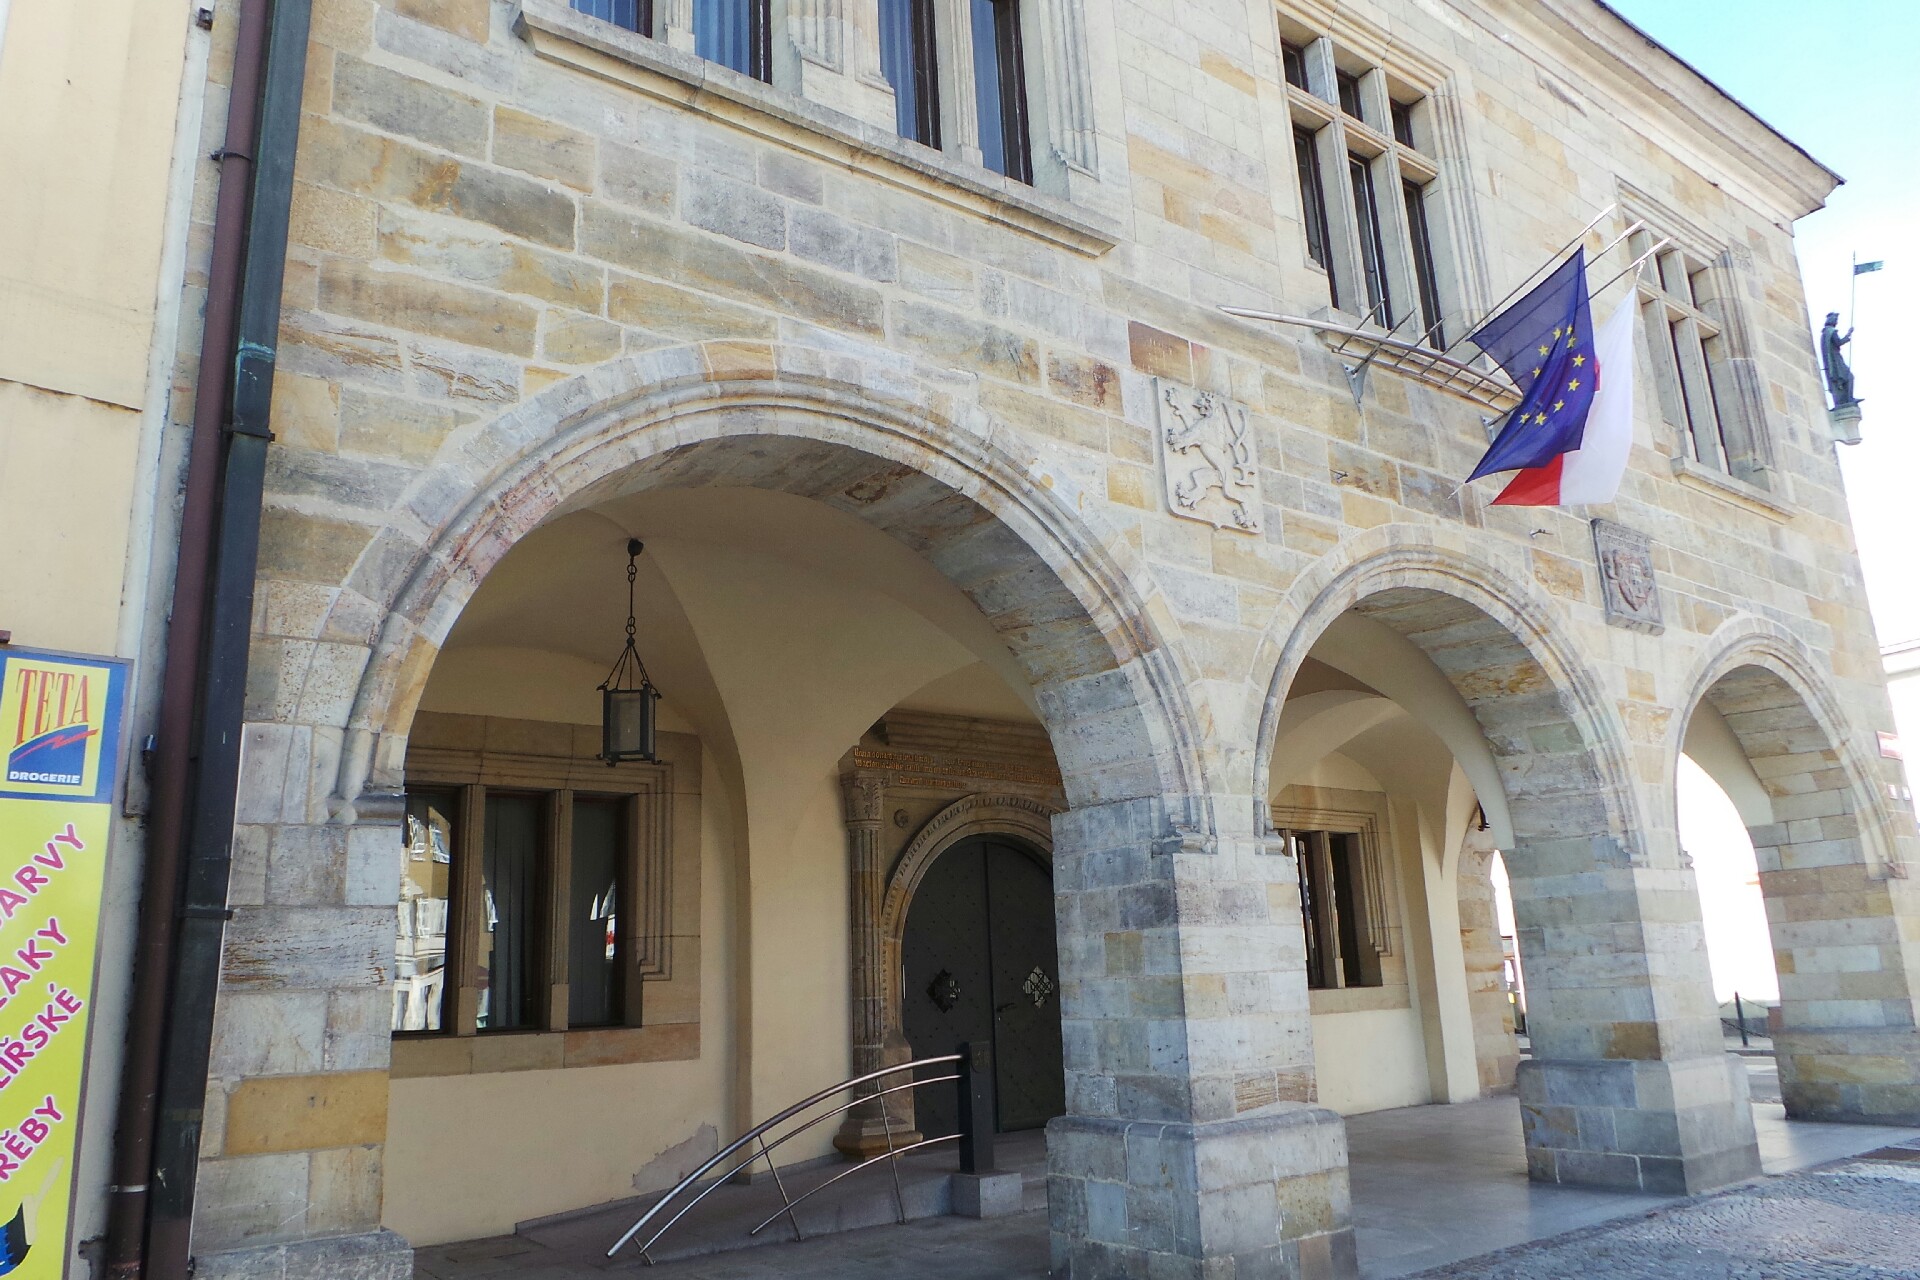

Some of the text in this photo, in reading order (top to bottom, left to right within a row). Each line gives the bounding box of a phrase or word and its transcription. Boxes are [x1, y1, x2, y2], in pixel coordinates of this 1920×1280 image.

[16, 668, 88, 748] TETA
[9, 771, 80, 784] DROGERIE
[0, 823, 84, 928] ARVY
[0, 918, 66, 1008] AKY
